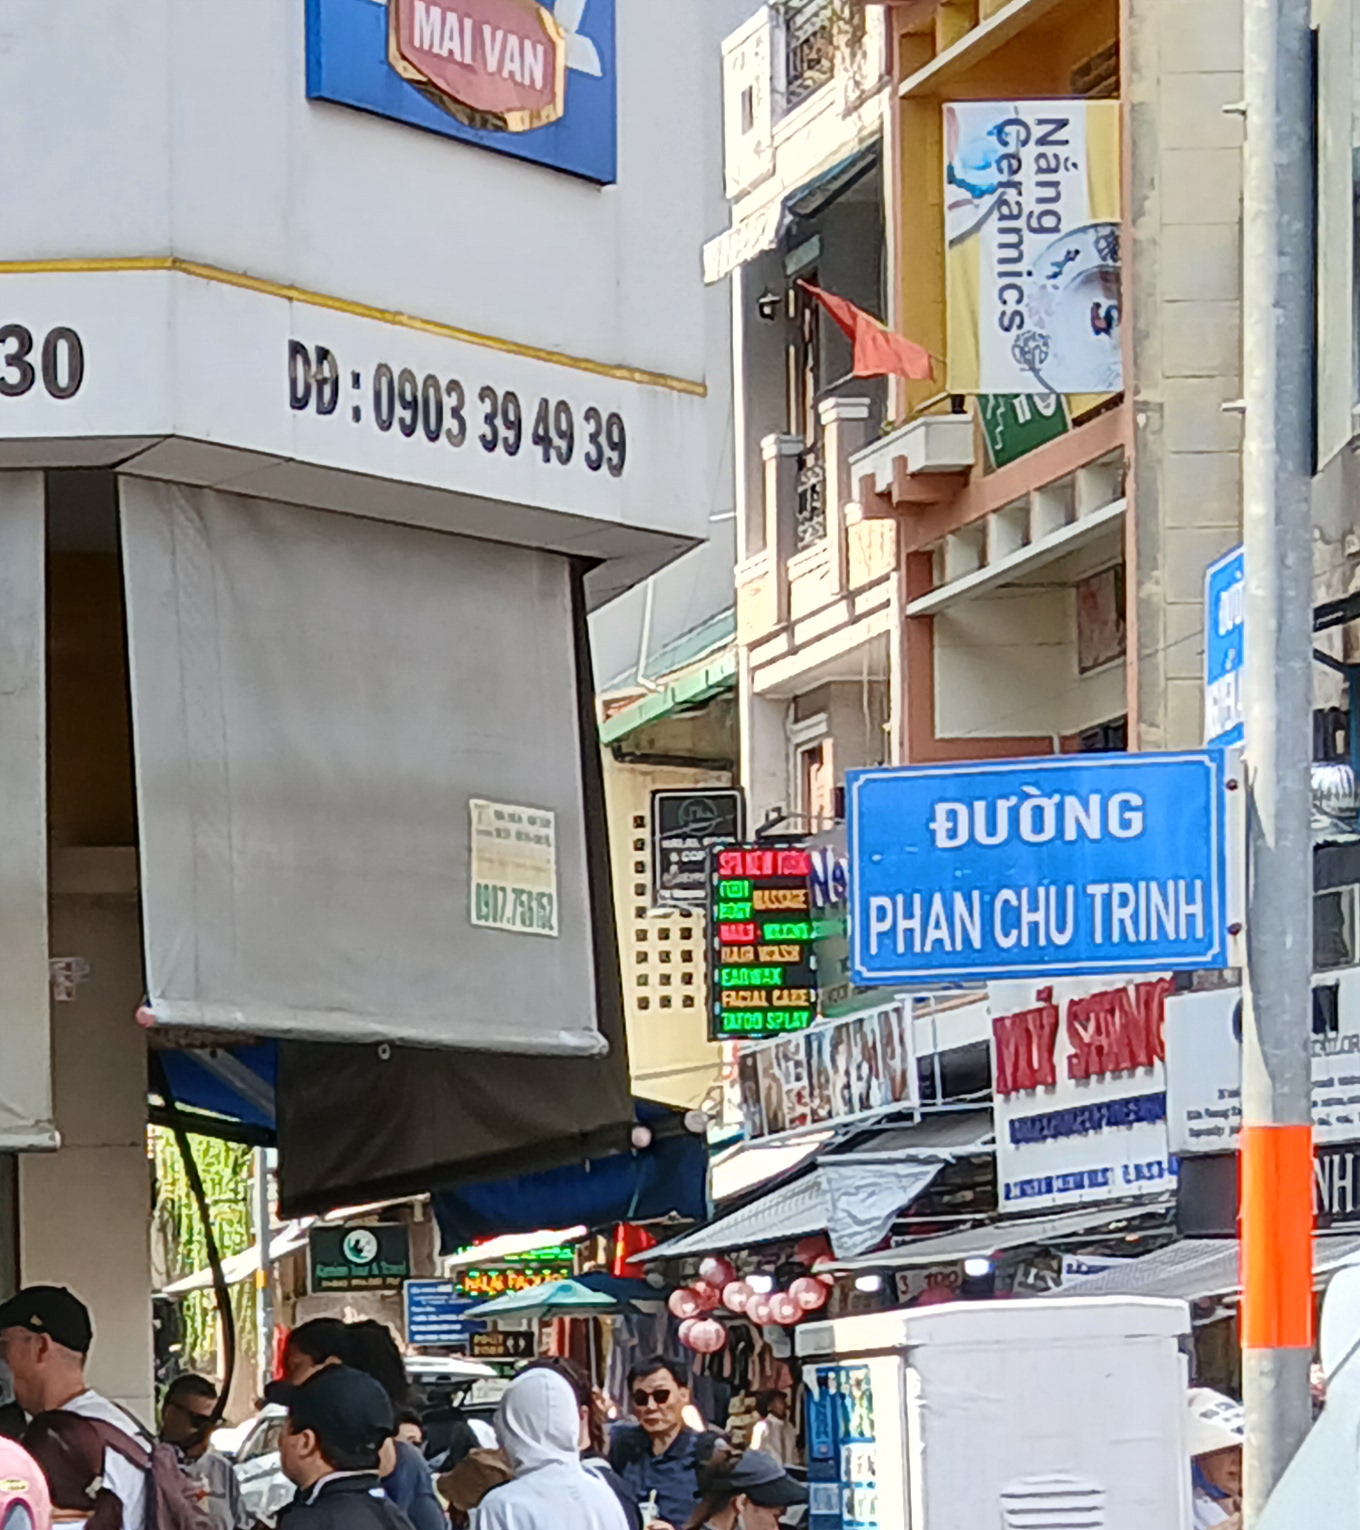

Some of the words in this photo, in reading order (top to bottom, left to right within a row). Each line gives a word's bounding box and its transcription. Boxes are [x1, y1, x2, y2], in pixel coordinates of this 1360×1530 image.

[414, 1, 473, 64] MAI
[482, 24, 544, 90] VAN
[996, 118, 1032, 333] Ceramics
[1027, 118, 1078, 235] Nắng
[374, 363, 466, 447] 0903
[479, 386, 521, 456] 39
[532, 397, 573, 465] 49
[584, 407, 626, 477] 39
[930, 785, 1144, 848] ĐƯỜNG
[870, 890, 980, 954] PHAN
[994, 885, 1074, 948] CHU
[1087, 879, 1204, 944] TRINH
